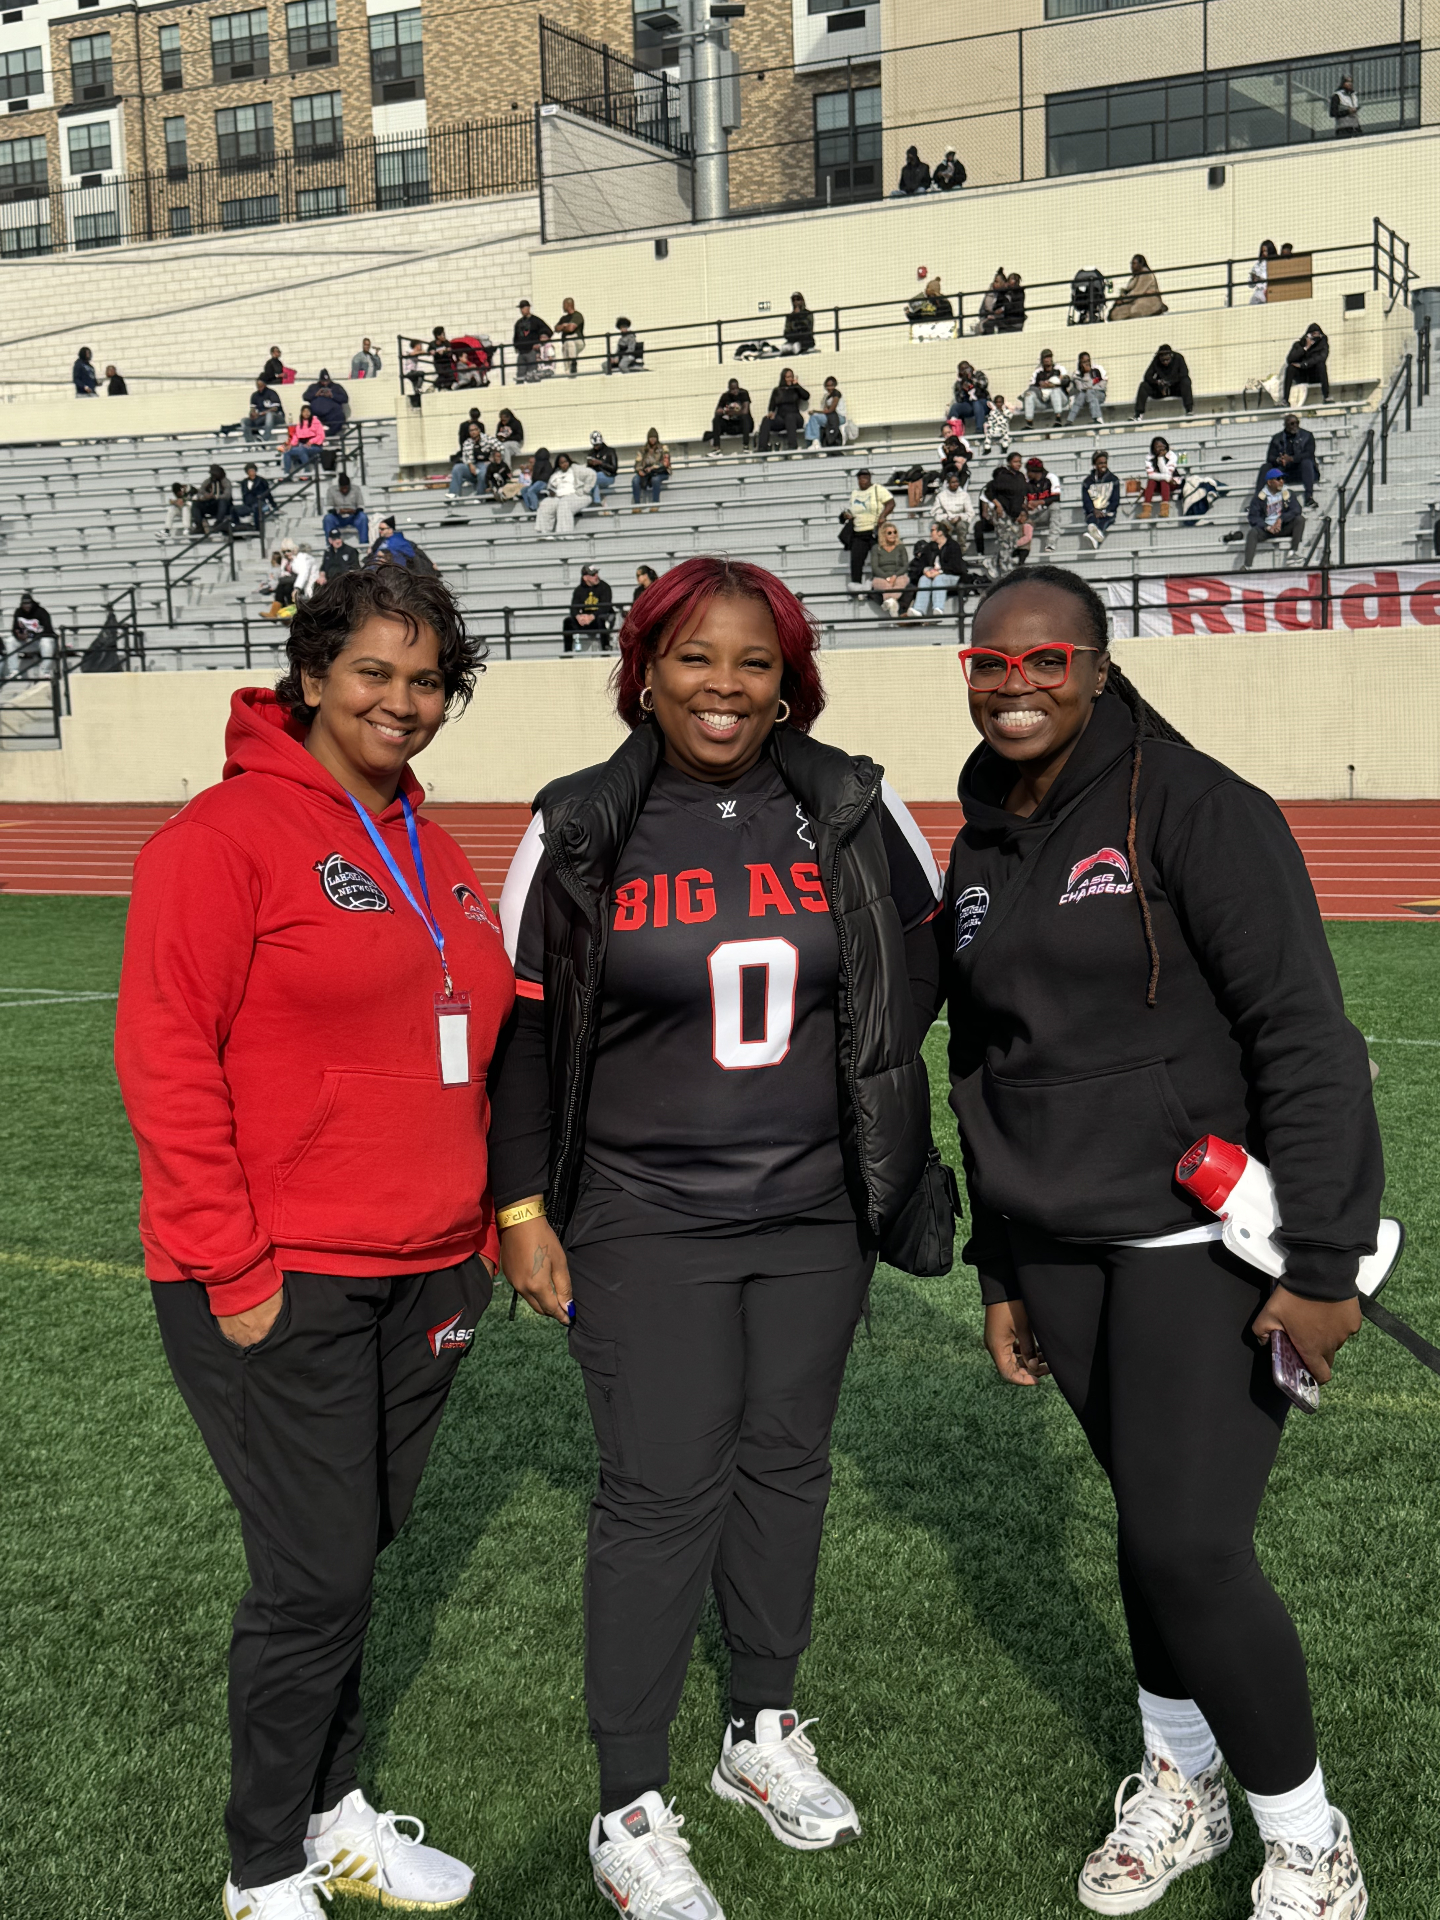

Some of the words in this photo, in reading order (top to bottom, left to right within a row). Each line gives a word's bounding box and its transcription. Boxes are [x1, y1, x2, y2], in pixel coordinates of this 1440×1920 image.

[1058, 881, 1134, 906] CHARGERS
[1077, 873, 1115, 890] ASG
[613, 868, 717, 931] BIG
[707, 936, 799, 1070] 0
[512, 1207, 533, 1221] VIP
